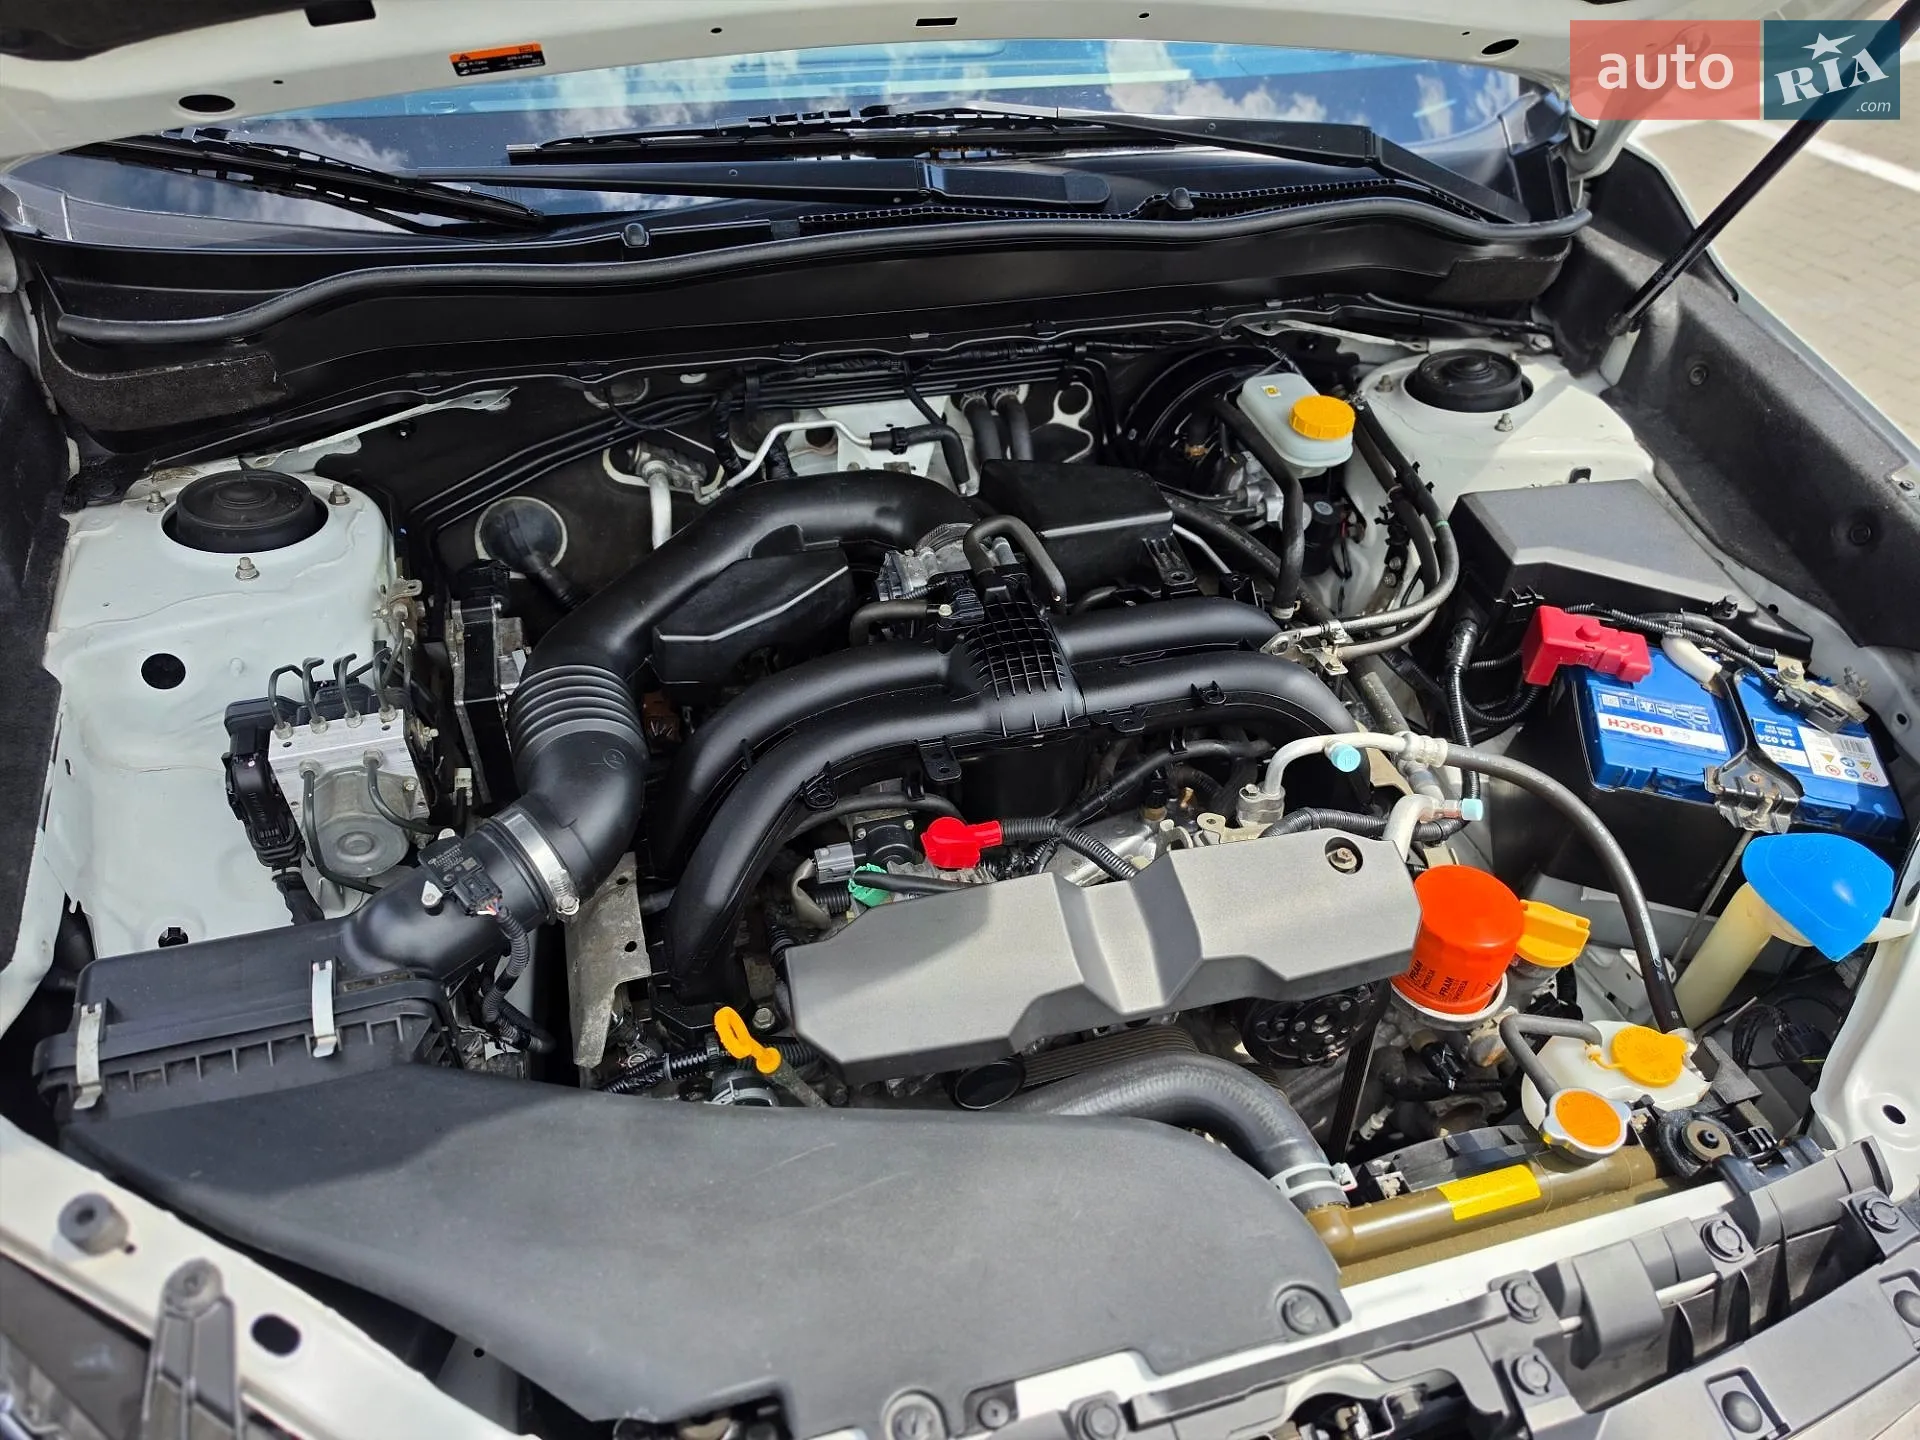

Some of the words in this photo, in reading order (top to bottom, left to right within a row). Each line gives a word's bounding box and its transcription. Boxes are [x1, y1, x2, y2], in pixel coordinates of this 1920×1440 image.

[1607, 717, 1664, 736] BOSCH
[1409, 960, 1424, 980] FRAM
[1439, 976, 1454, 996] FRAM
